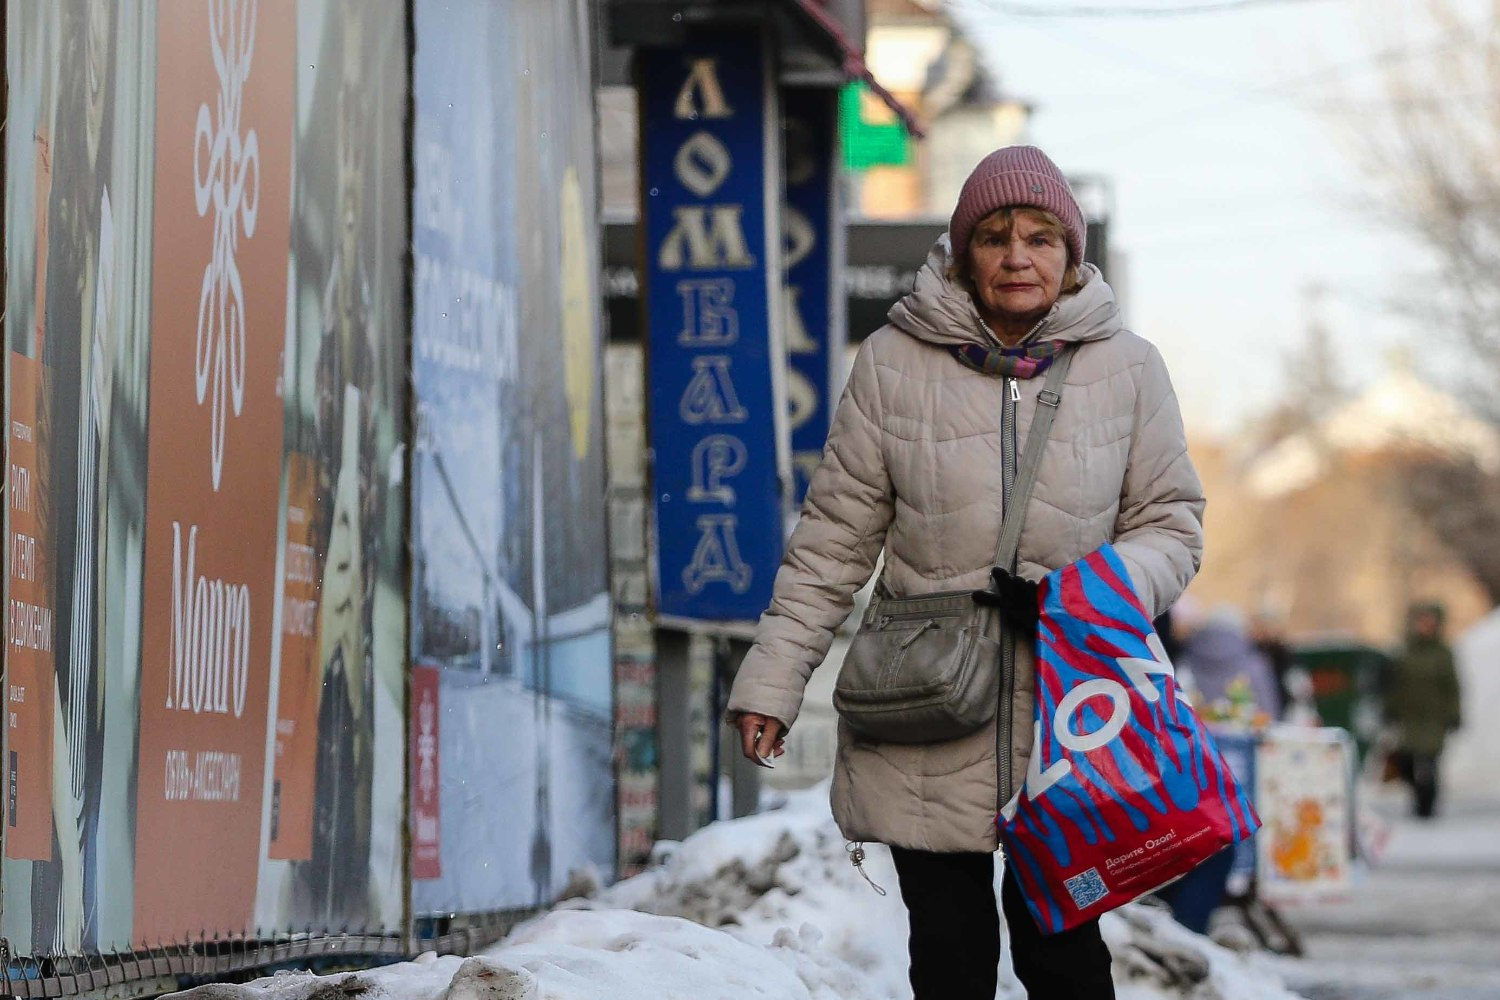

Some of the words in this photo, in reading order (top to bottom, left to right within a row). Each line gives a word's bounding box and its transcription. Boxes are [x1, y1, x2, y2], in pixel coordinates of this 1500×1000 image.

[657, 56, 757, 596] ЛОМБАРД
[11, 463, 31, 513] РИТМ
[18, 534, 36, 582] ТЕМП
[10, 598, 16, 645] В
[16, 601, 52, 654] ДВИЖЕНИИ
[165, 520, 251, 719] Monro
[999, 631, 1176, 822] ZON
[1105, 846, 1144, 869] Дарите
[1144, 828, 1177, 850] Ozon!
